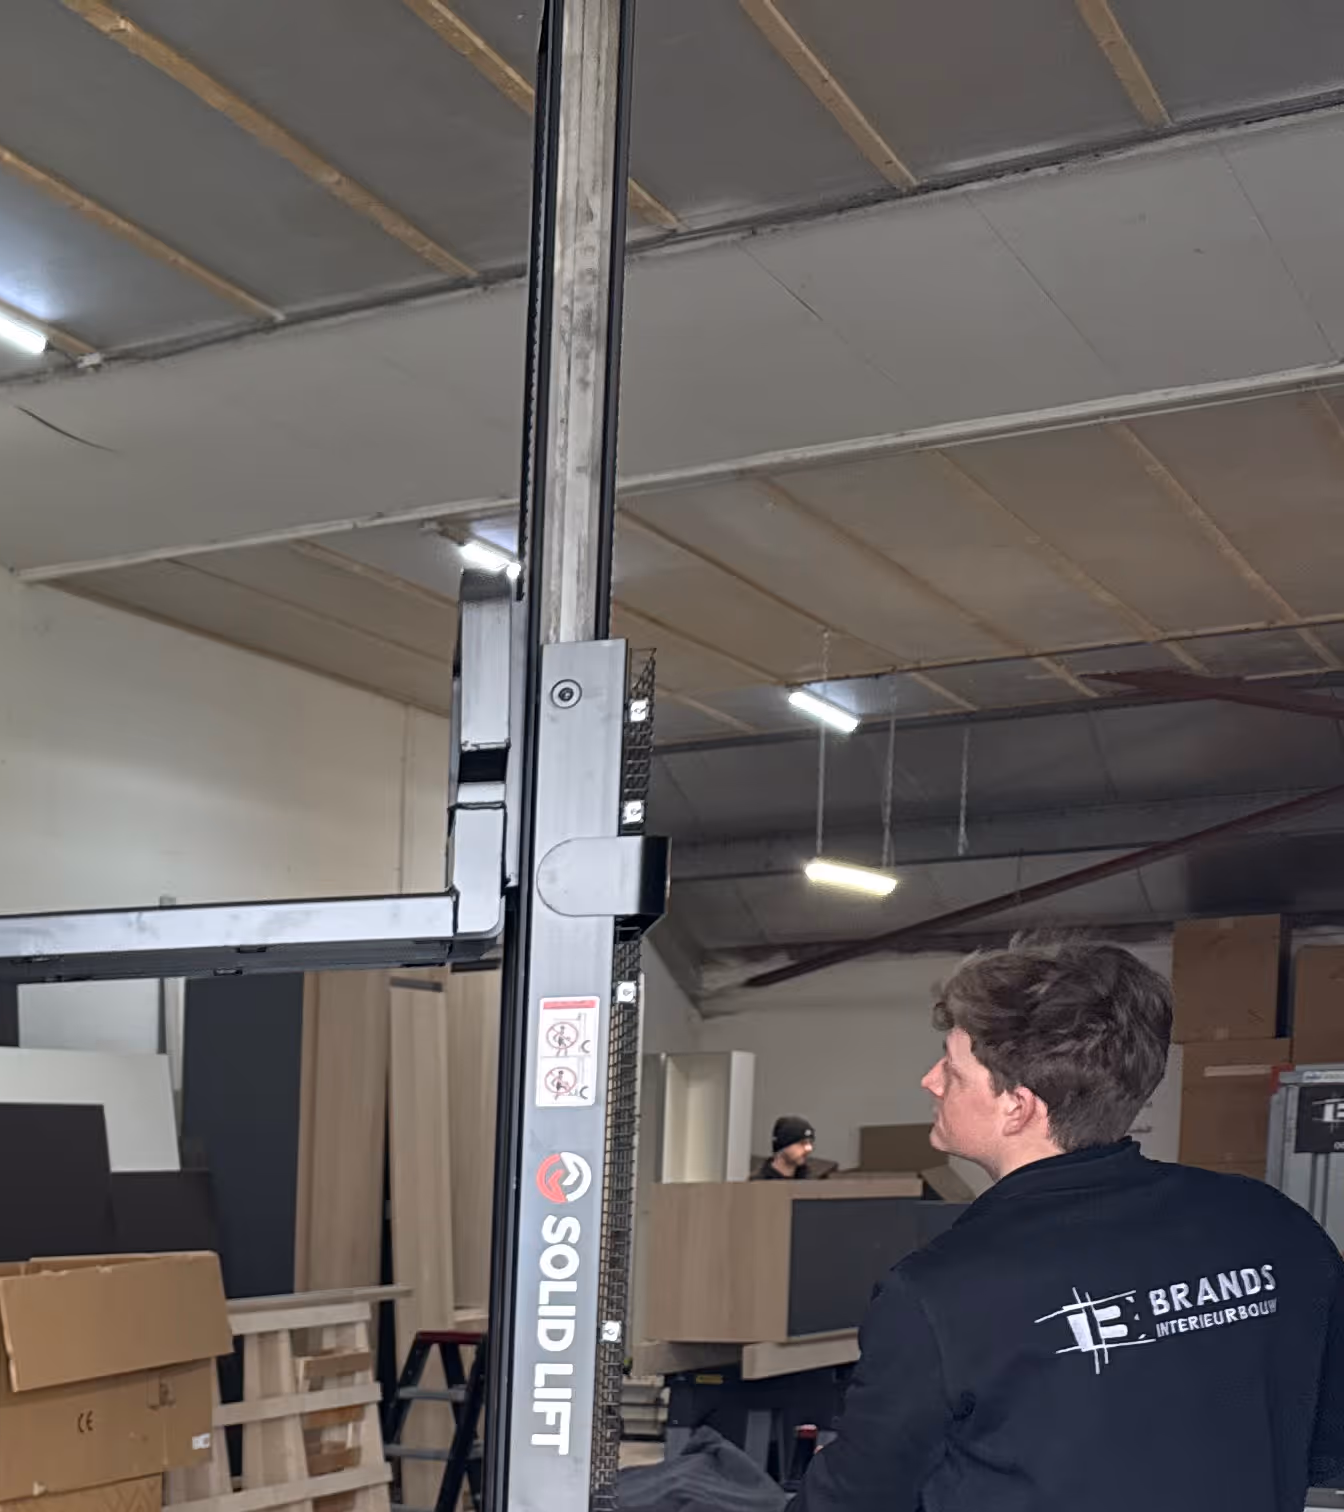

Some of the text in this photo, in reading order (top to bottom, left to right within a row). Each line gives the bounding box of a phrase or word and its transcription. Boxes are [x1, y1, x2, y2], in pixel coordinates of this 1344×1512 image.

[1149, 1264, 1277, 1317] BRANDS
[530, 1214, 581, 1456] SOLID LIFT
[1155, 1297, 1278, 1338] INTERIEURBOUW
[77, 1410, 94, 1433] CE
